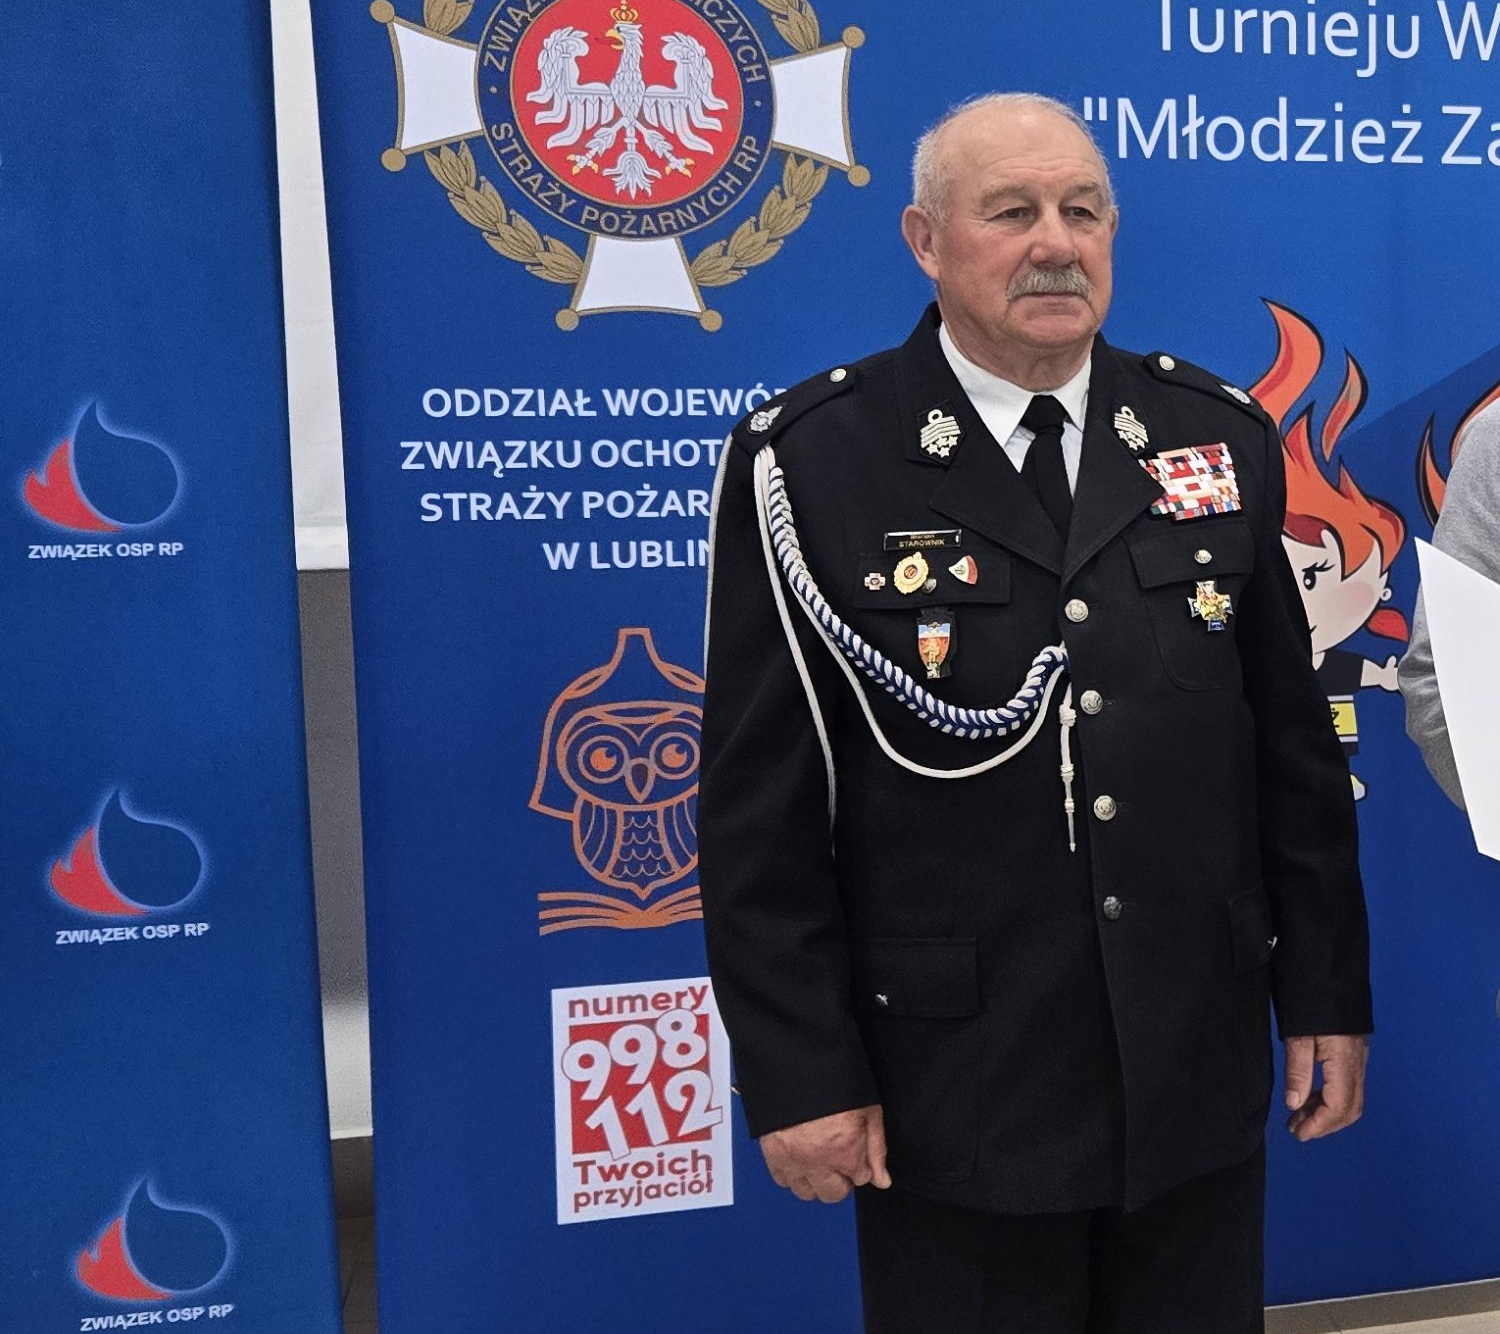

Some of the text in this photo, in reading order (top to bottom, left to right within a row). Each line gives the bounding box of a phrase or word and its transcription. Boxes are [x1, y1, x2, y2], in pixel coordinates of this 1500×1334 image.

[1083, 93, 1424, 165] "Młodzież
[491, 122, 760, 237] STRAŻY POŻARNYCH RP
[422, 382, 790, 418] ODDZIAŁ WOJEWÓ
[400, 438, 723, 478] ZWIĄZKU OCHOT
[420, 483, 710, 522] STRAŻY POŻAR
[27, 542, 184, 561] ZWIĄZEK OSP RP
[542, 542, 580, 570] W
[55, 922, 210, 945] ZWIĄZEK OSP RP
[568, 984, 709, 1019] numery
[561, 1008, 707, 1101] 998
[585, 1069, 723, 1161] 112
[573, 1149, 713, 1185] Twoich
[574, 1171, 714, 1213] przyjaciół
[80, 1303, 235, 1332] ZWIĄZEK OSP RP
